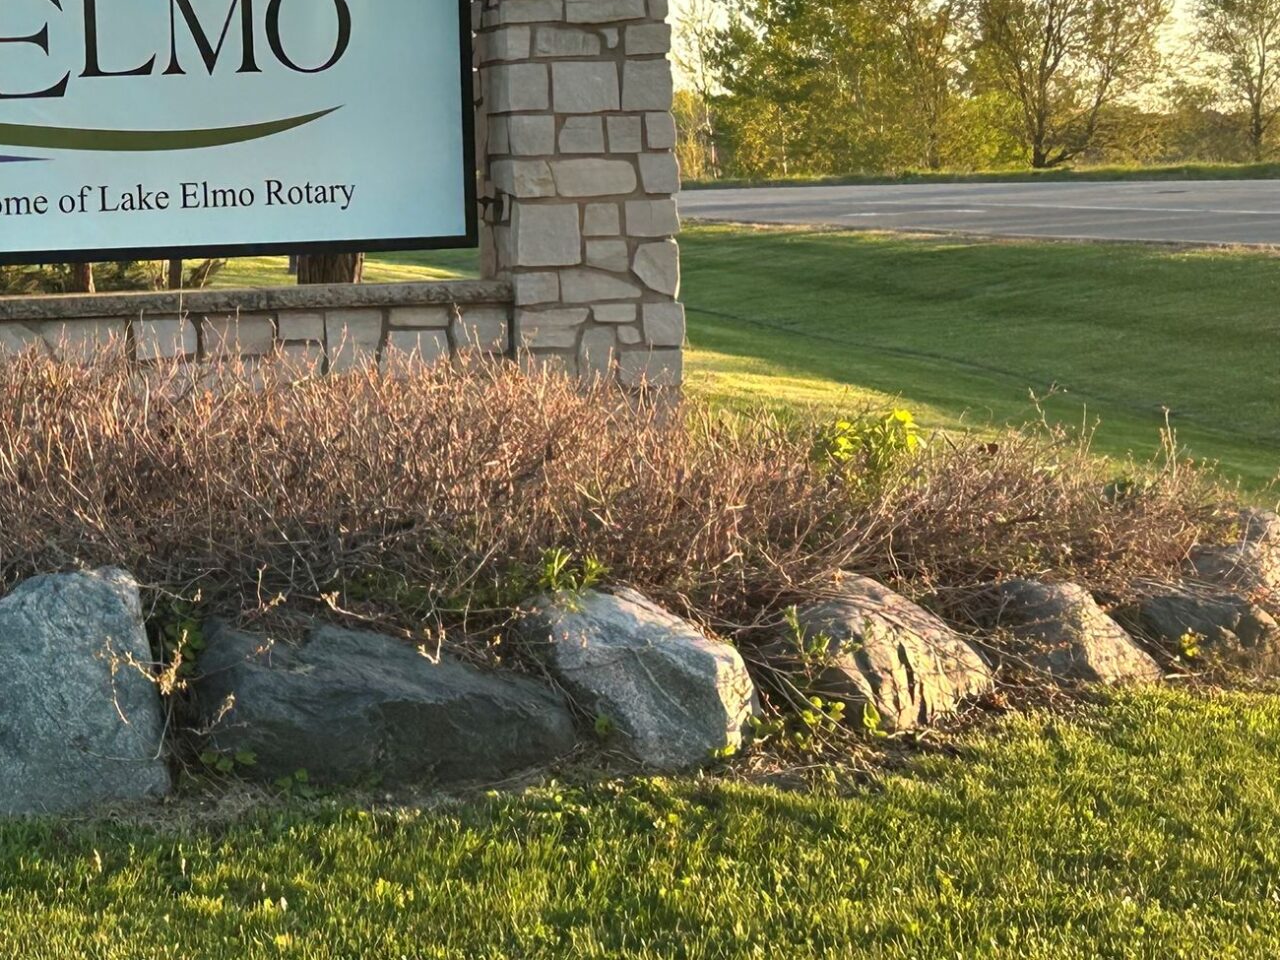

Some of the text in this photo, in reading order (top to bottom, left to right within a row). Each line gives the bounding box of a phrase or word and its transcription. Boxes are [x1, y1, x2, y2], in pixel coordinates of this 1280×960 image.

[58, 185, 93, 214] of
[97, 184, 170, 213] Lake
[179, 180, 255, 209] Elmo
[265, 179, 356, 211] Rotary
